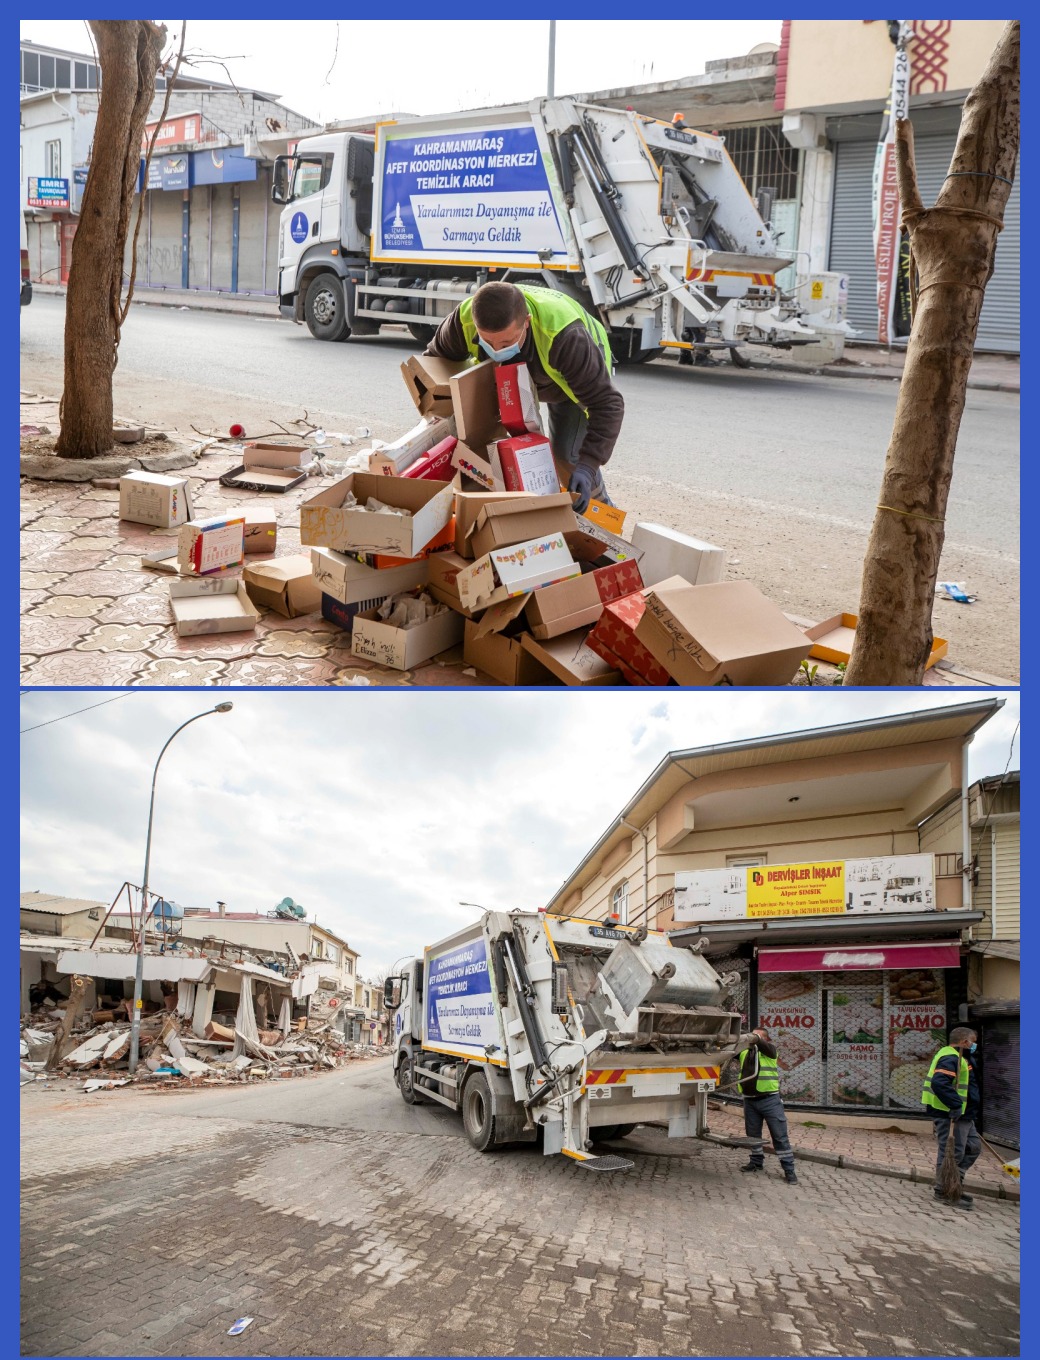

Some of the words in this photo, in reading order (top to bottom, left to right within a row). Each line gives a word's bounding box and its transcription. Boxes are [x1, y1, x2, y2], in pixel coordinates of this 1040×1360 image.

[895, 78, 907, 120] 0544
[413, 137, 504, 156] KAHRAMANMARAŞ
[386, 161, 408, 175] AFET
[409, 156, 485, 173] KOORDİNASYON
[487, 150, 538, 168] MERKEZİ
[40, 180, 65, 188] EMRE
[417, 174, 461, 190] TEMİZLİK
[462, 174, 494, 188] ARACI
[417, 204, 474, 219] Yaralarımızı
[476, 203, 535, 221] Dayanışma
[538, 202, 552, 217] ile
[882, 188, 898, 227] PROJE
[443, 227, 486, 244] Sarmaya
[488, 227, 522, 242] Geldik
[767, 868, 811, 883] DERVİŞLER
[812, 866, 842, 881] İNŞAAT
[597, 928, 604, 936] 35
[438, 950, 474, 970] KAHRAMANMARAŞ
[436, 967, 464, 984] KOORDİNASYON
[465, 961, 488, 975] MERKEZİ
[438, 983, 454, 996] TEMİZLİK
[454, 981, 468, 992] ARACI
[760, 1015, 815, 1029] KAMO
[890, 1014, 945, 1029] KAMO
